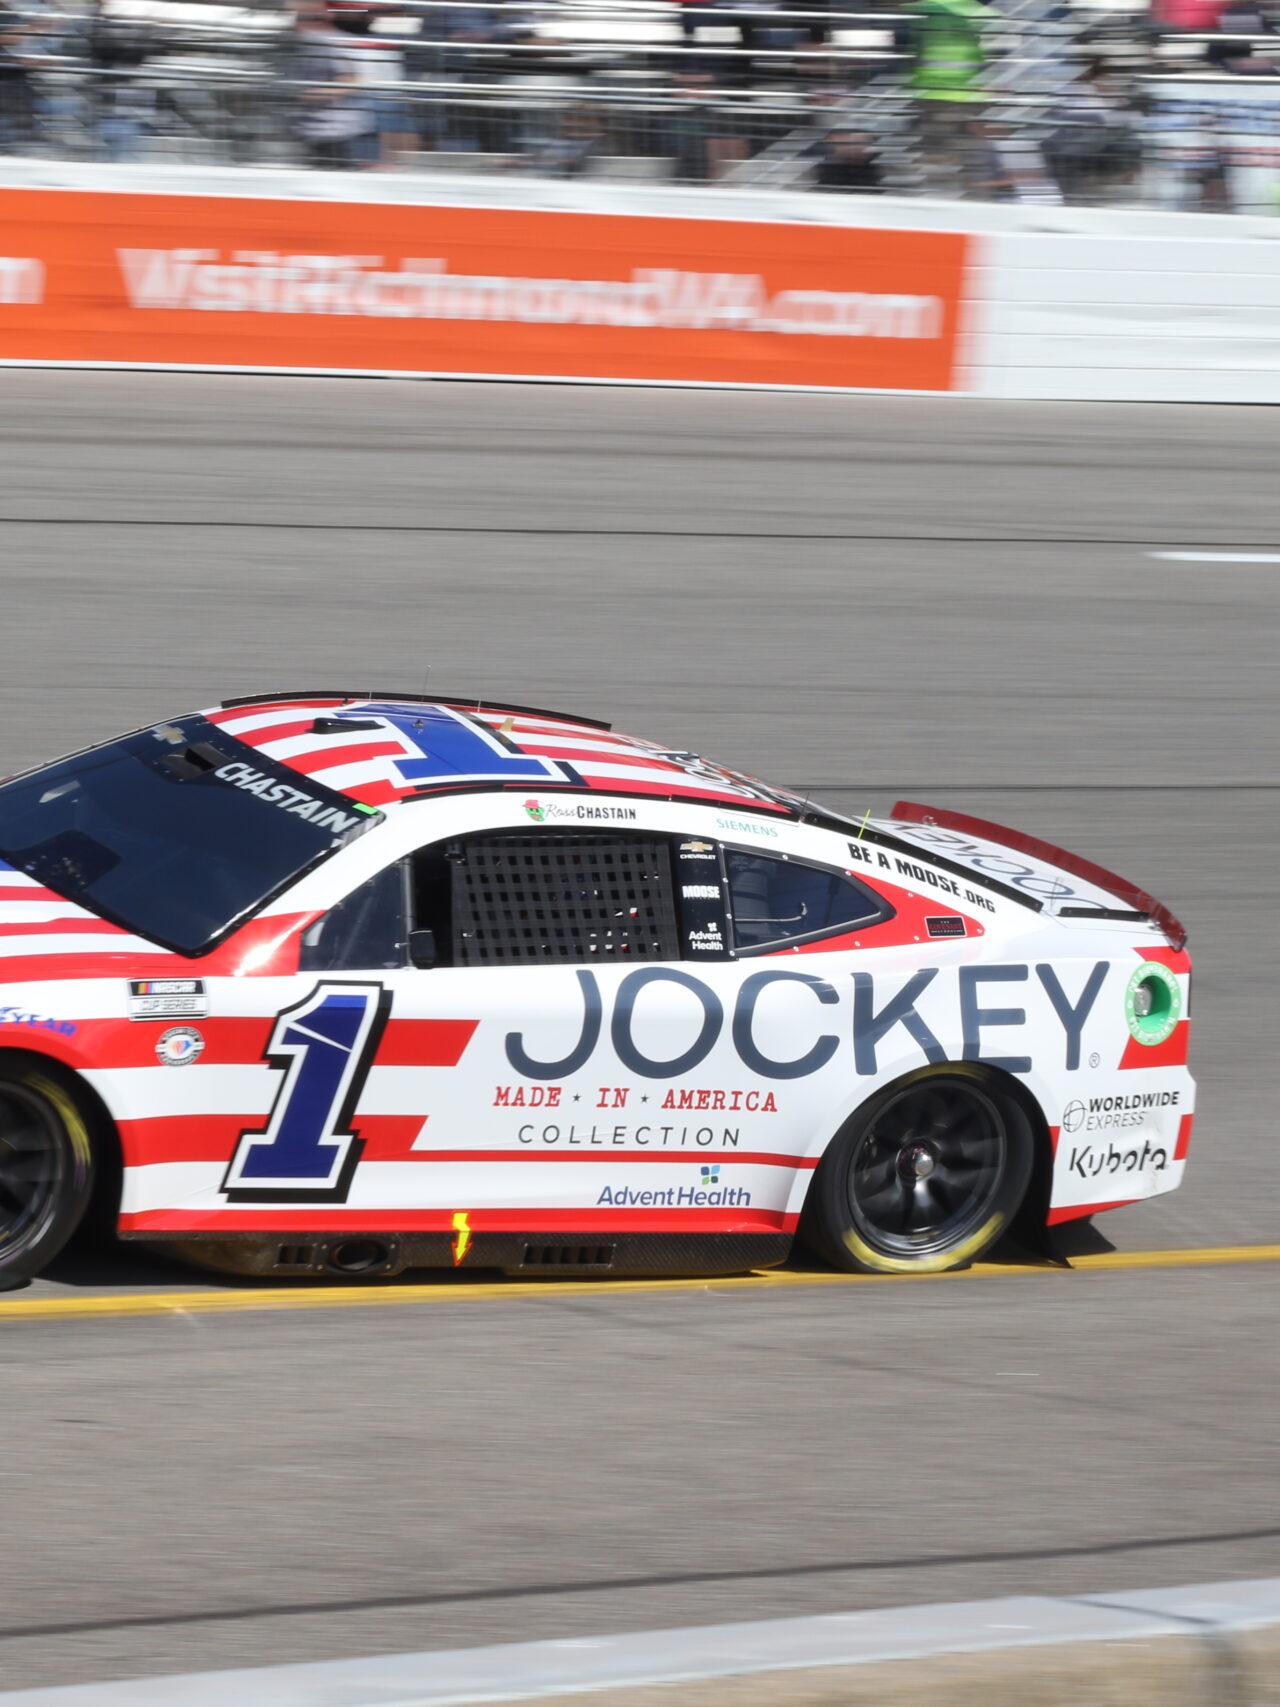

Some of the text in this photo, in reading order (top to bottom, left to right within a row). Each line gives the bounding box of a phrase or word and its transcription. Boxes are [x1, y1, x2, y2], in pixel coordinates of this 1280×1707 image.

[214, 762, 361, 834] CHASTAIN
[576, 805, 636, 820] CHASTAIN
[716, 818, 779, 838] SIEMENS
[847, 842, 873, 865] BE
[877, 851, 891, 871] A
[682, 885, 721, 899] MOOSE
[688, 931, 723, 941] Advent
[691, 941, 724, 951] Health
[504, 960, 1110, 1080] JOCKEY
[218, 980, 394, 1204] 1
[493, 1086, 778, 1112] MADE IN AMERICA
[1089, 1091, 1180, 1113] WORLDWIDE
[1086, 1111, 1145, 1131] EXPRESS
[518, 1124, 740, 1147] COLLECTION
[1068, 1139, 1168, 1178] Kubota
